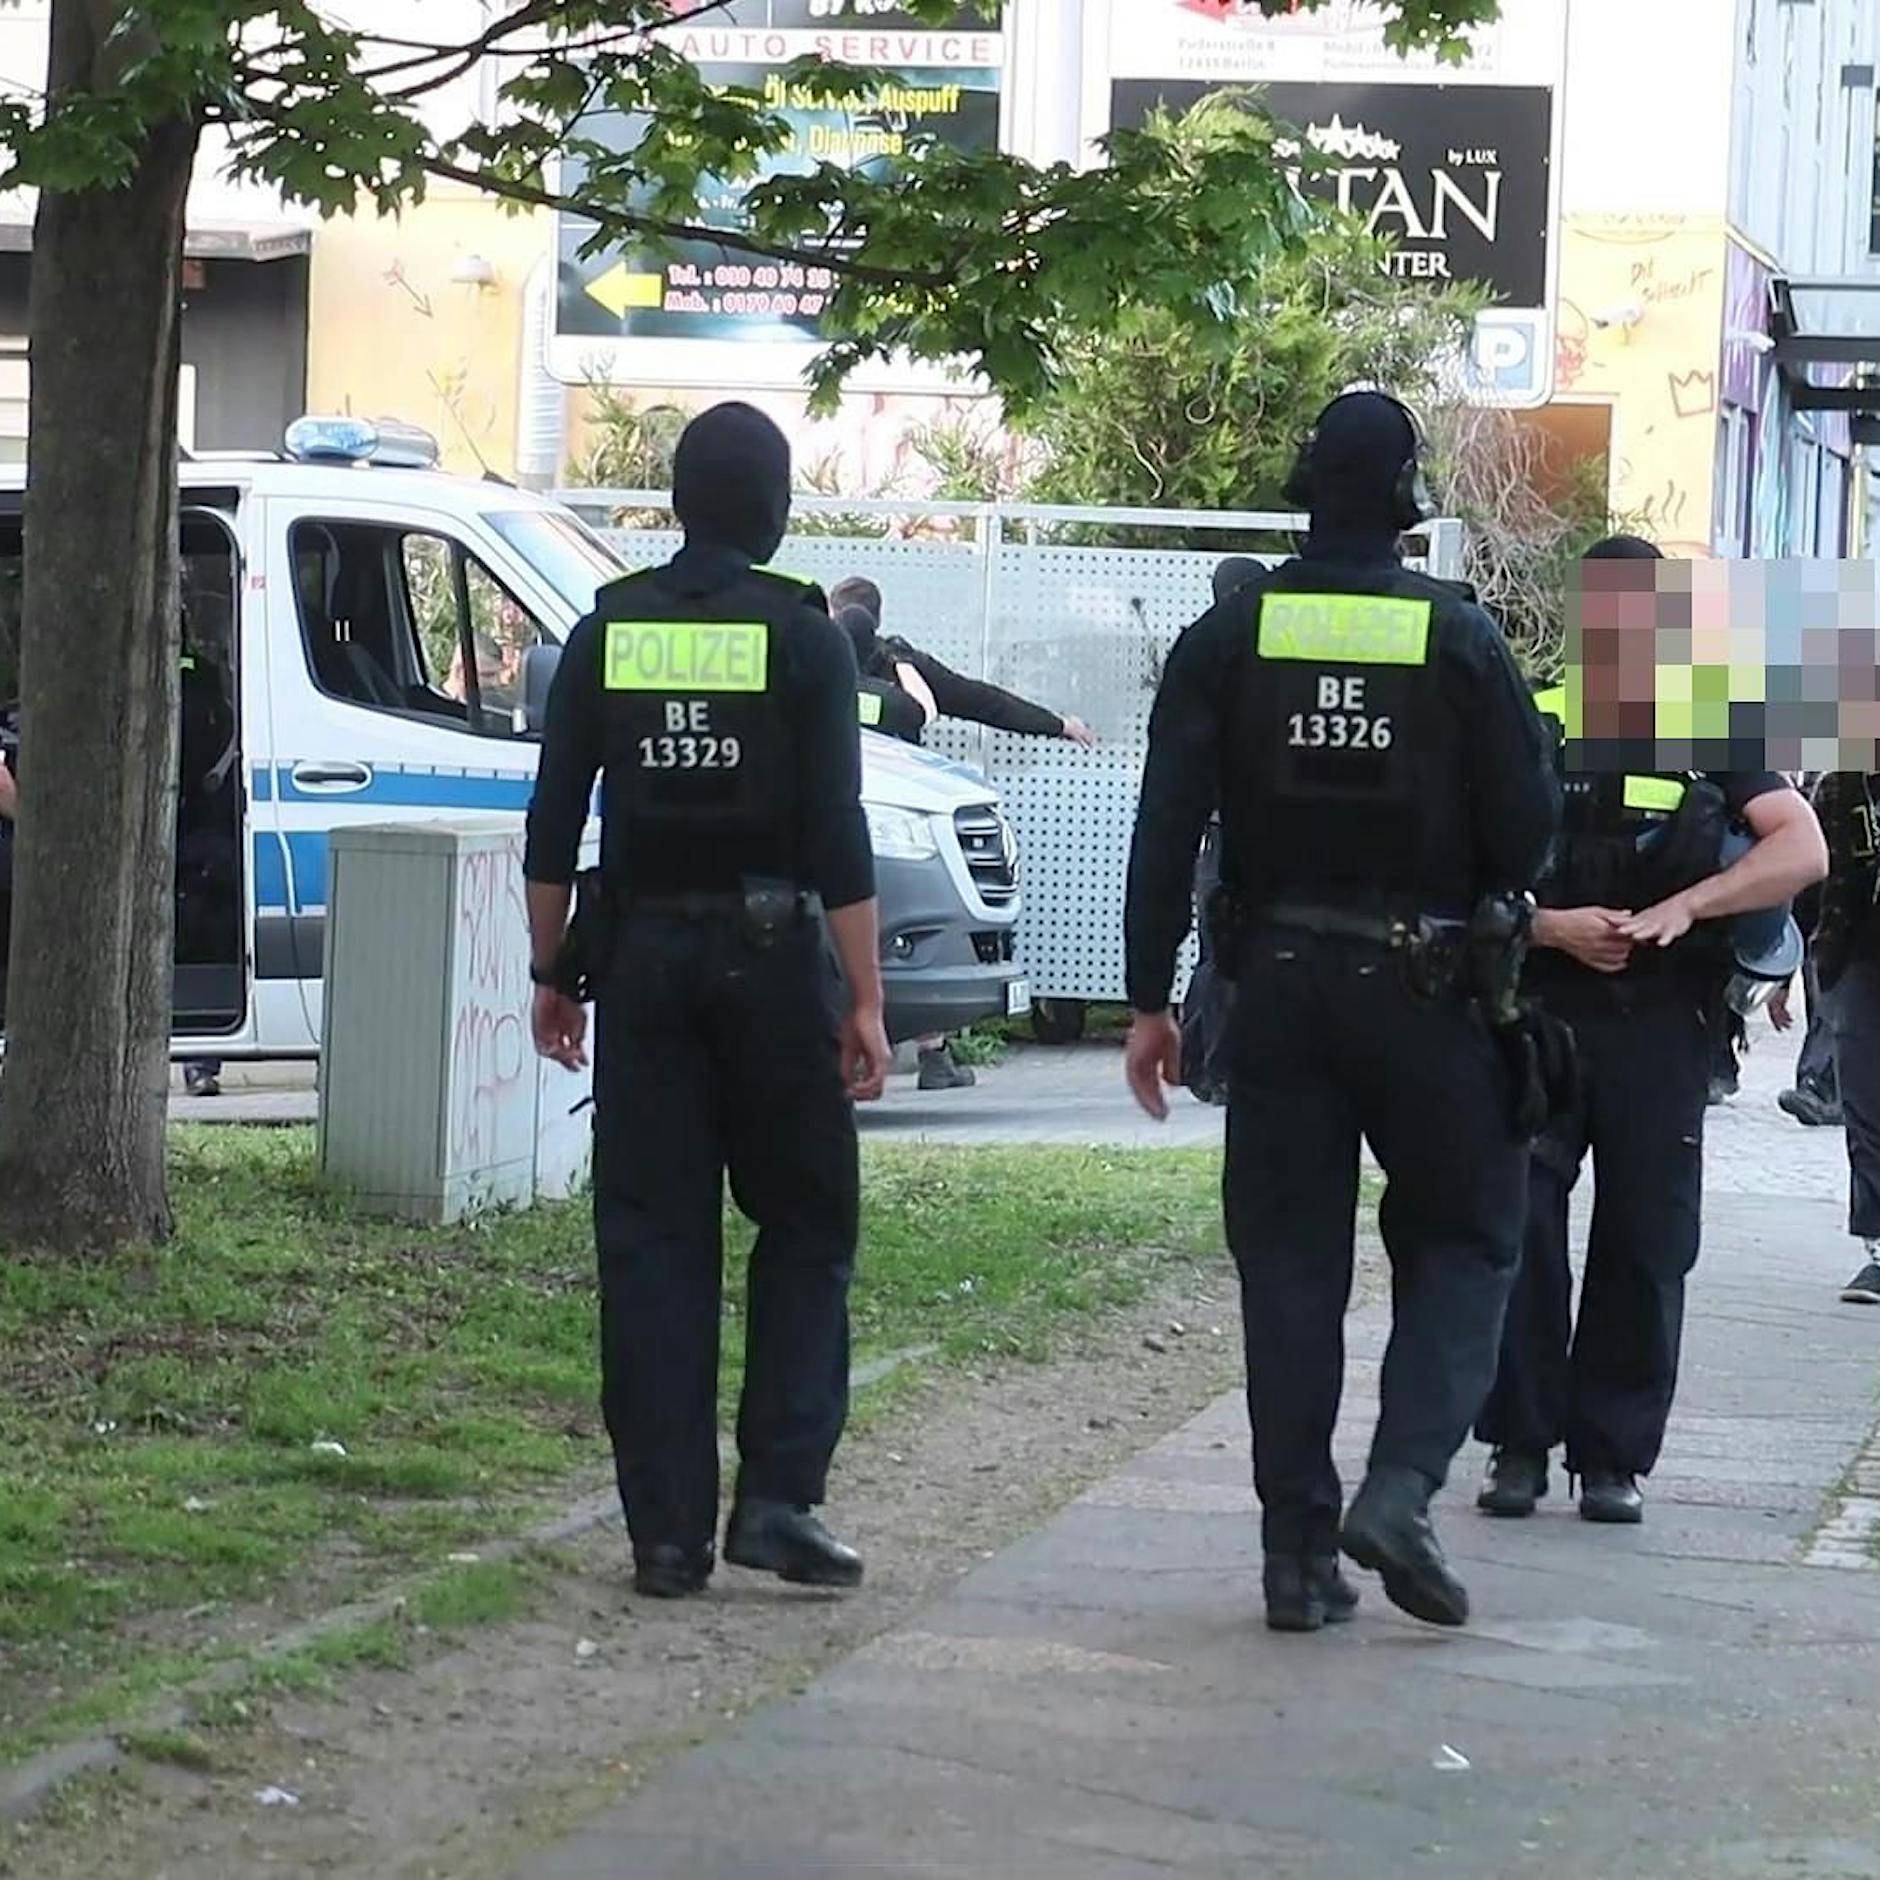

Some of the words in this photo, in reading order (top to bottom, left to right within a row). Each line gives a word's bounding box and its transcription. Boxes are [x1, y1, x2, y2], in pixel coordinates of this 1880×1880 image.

[682, 33, 787, 58] AUTO
[815, 34, 991, 62] SERVICE
[878, 84, 961, 120] Auspuff
[1448, 149, 1463, 167] by
[1466, 150, 1497, 165] LUX
[611, 628, 761, 683] POLIZEI
[1317, 674, 1366, 711] BE
[664, 700, 710, 733] BE
[1287, 713, 1393, 750] 13326
[637, 736, 741, 769] 13329
